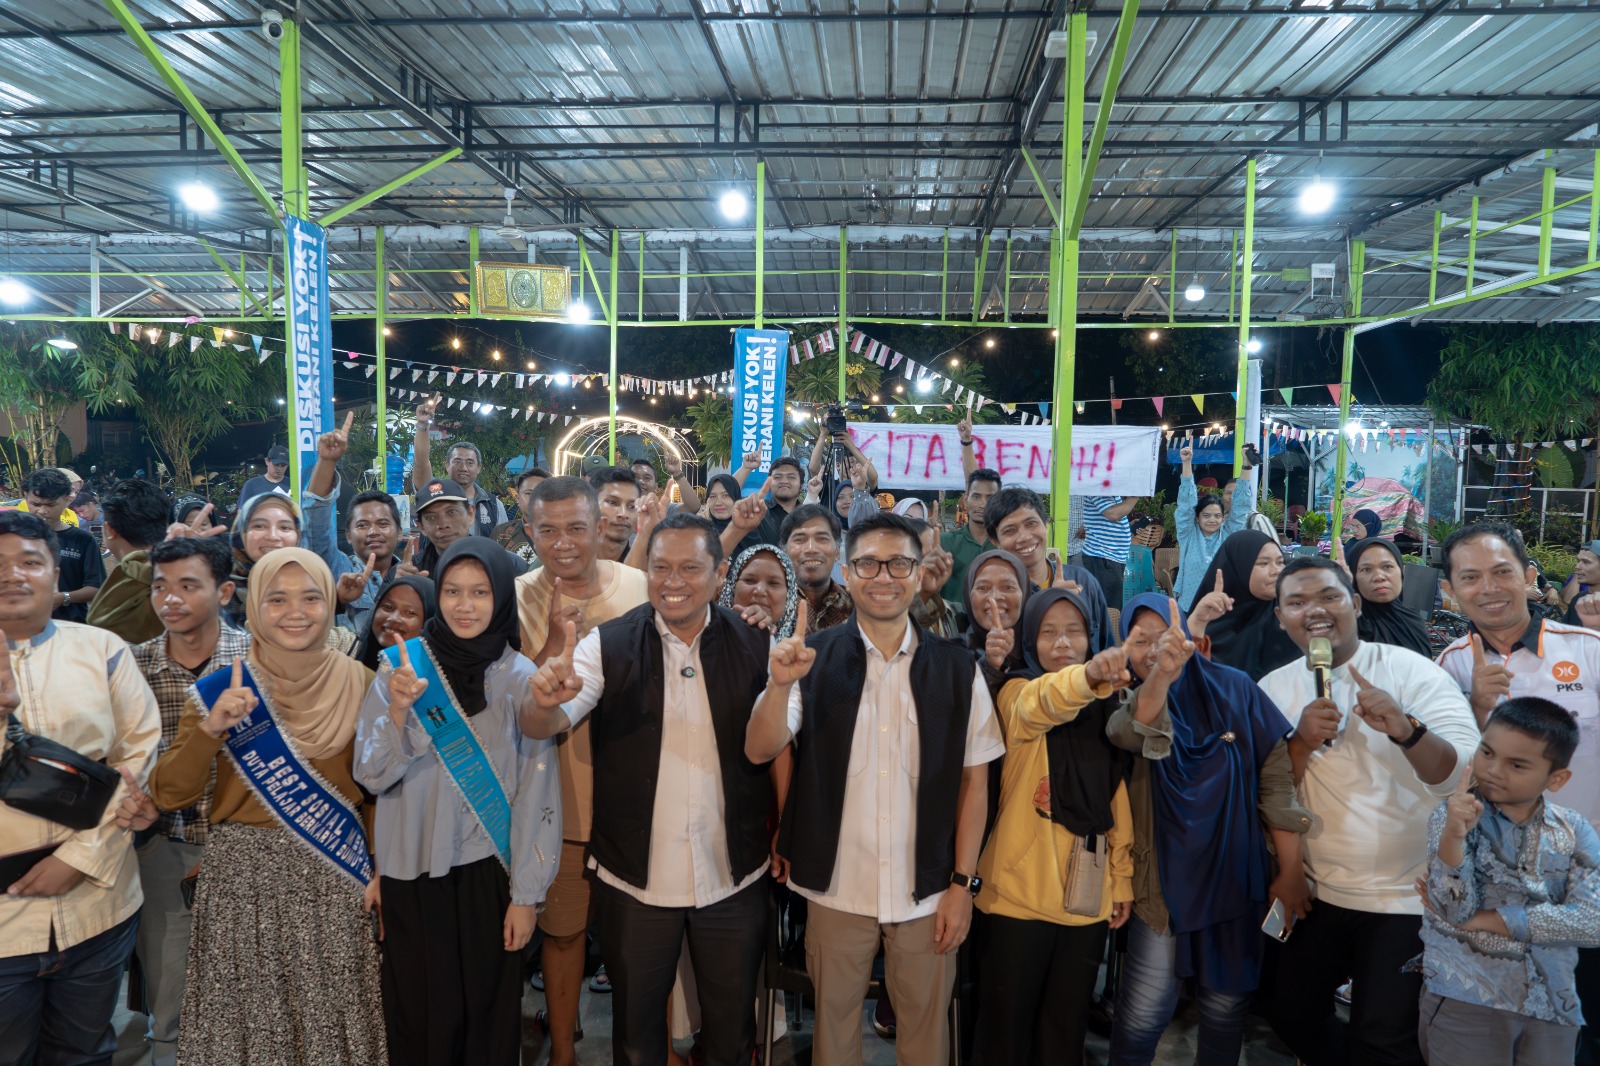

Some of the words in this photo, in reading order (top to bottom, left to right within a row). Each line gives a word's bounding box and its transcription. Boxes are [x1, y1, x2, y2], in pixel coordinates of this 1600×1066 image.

[296, 322, 314, 452] DISKUSI
[742, 394, 758, 472] SKUSI
[759, 407, 774, 473] BERANI
[1556, 682, 1583, 693] PKS
[441, 735, 474, 769] DUTA
[242, 749, 264, 779] DUTA
[261, 776, 301, 818] PELAJAR
[294, 811, 341, 852] BERKARYA
[335, 843, 364, 870] SUMUT
[268, 755, 308, 796] BEST
[301, 792, 348, 834] SOSIAL
[345, 827, 370, 862] MED
